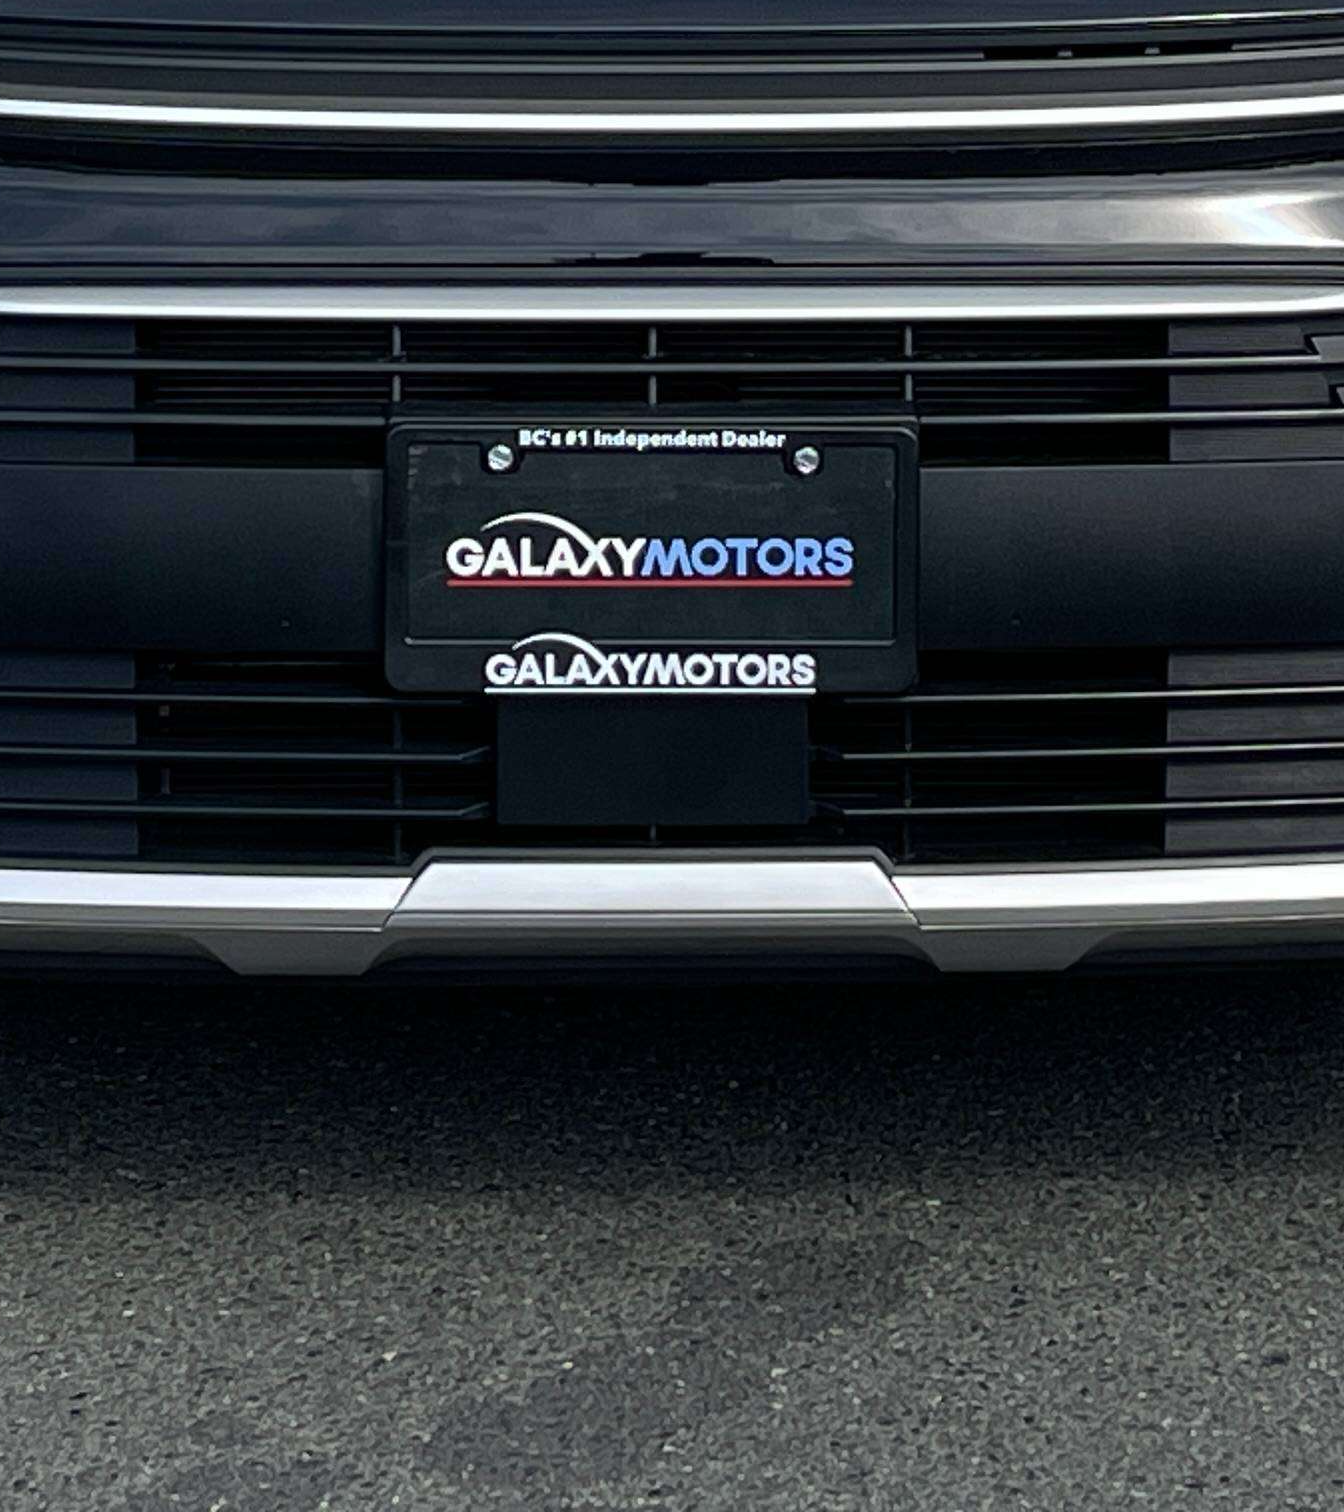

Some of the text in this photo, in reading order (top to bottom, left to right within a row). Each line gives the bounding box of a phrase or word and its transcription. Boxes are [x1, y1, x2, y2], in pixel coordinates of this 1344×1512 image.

[518, 429, 787, 452] BC's #1 Independent Dealer
